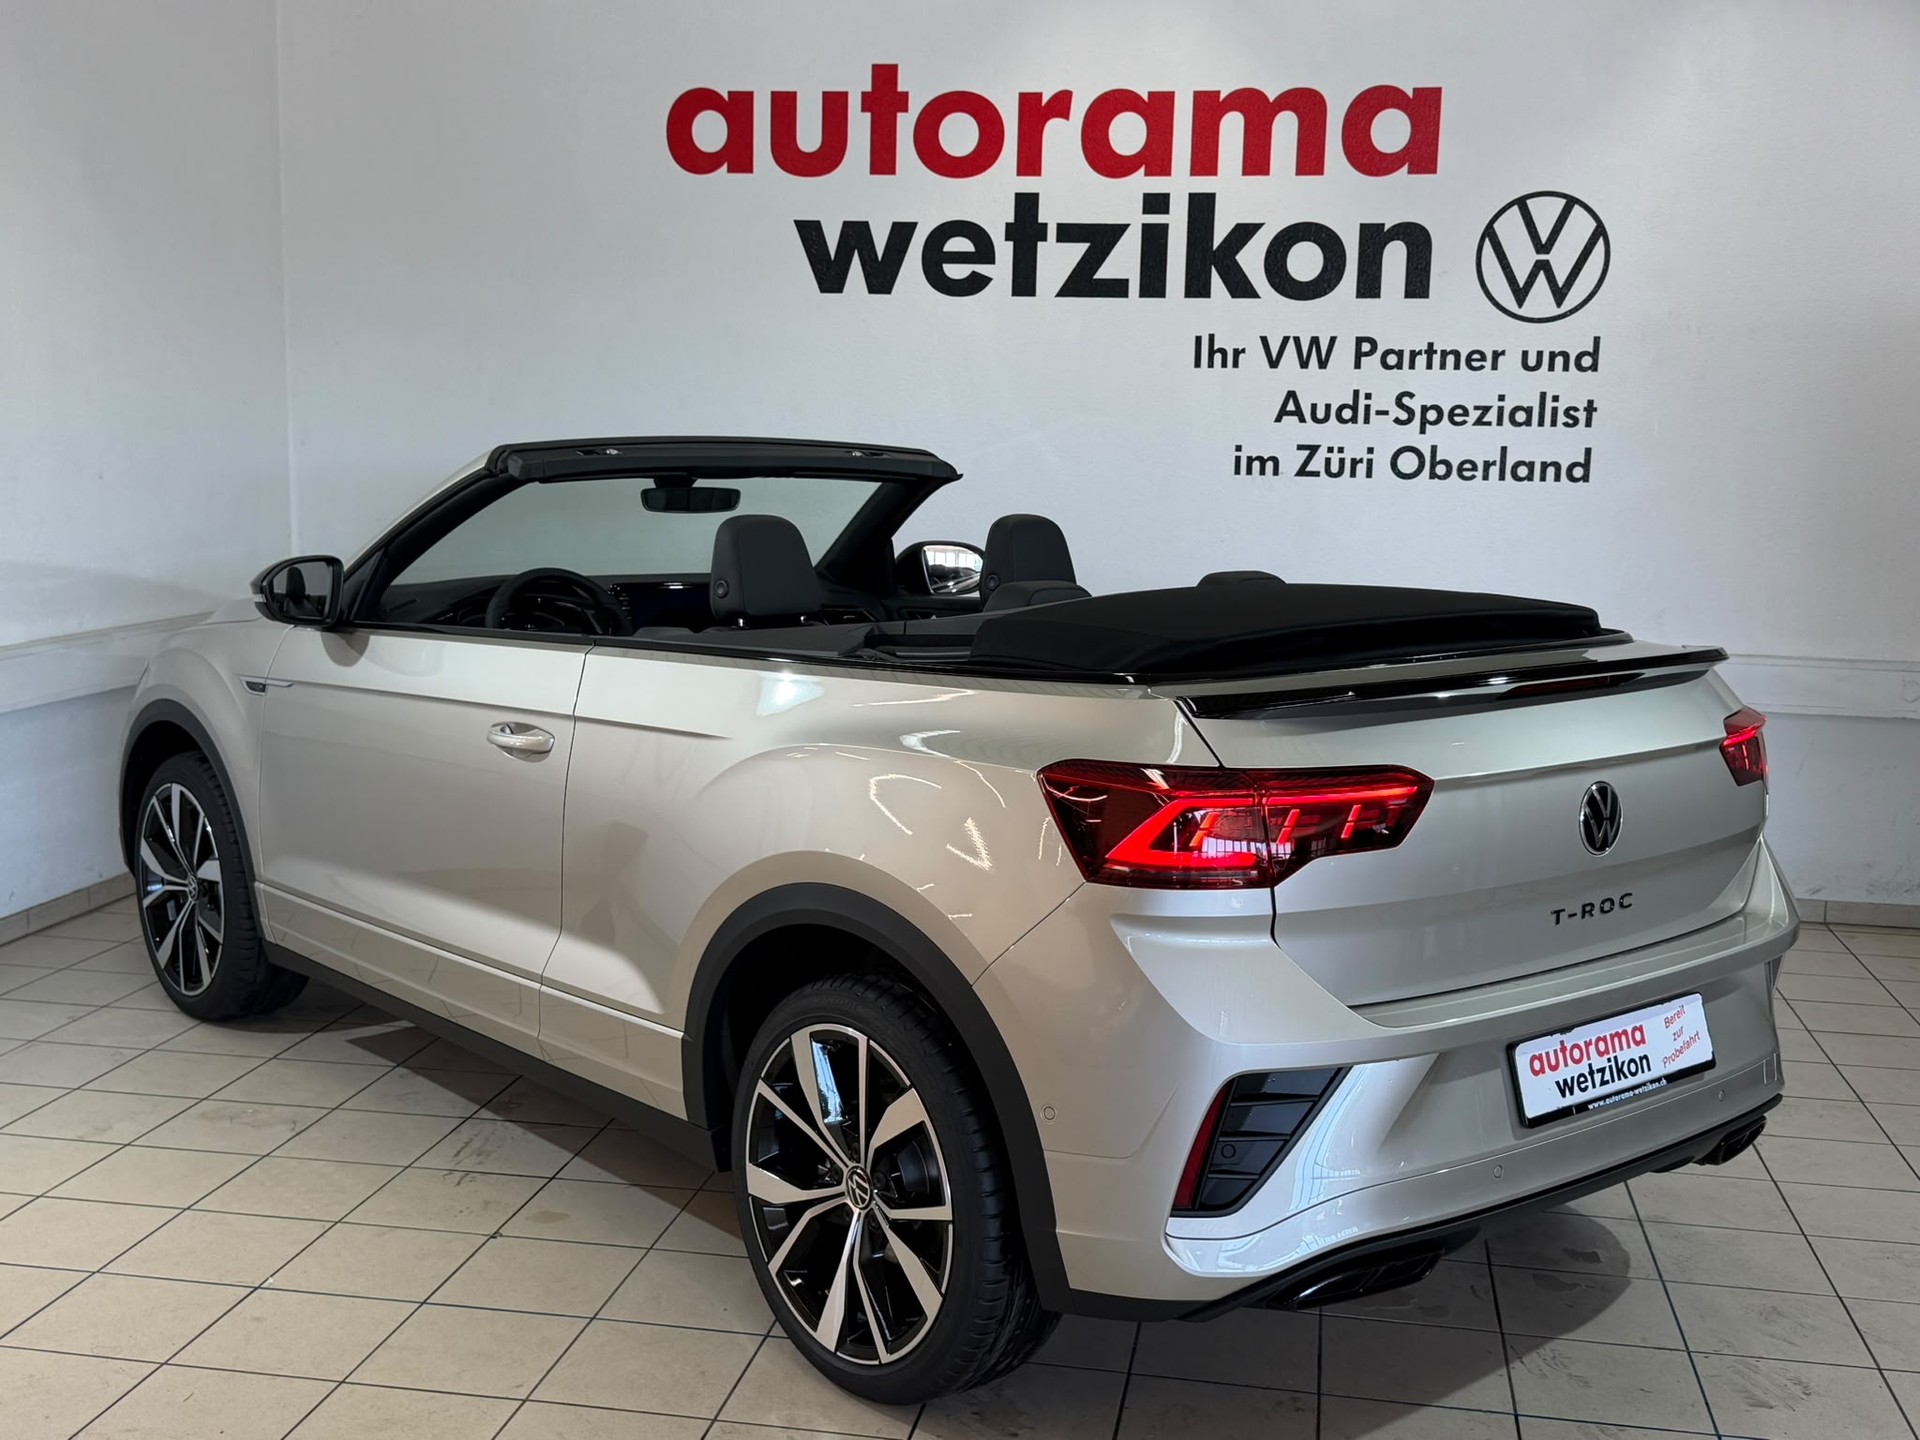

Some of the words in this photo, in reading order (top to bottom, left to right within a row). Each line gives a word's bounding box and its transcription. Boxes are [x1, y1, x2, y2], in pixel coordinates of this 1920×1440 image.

[666, 64, 1443, 180] autorama
[793, 192, 1433, 302] wetzikon
[1193, 333, 1246, 370] Ihr
[1259, 335, 1338, 370] VW
[1353, 336, 1506, 372] Partner
[1521, 335, 1601, 373] und
[1273, 389, 1598, 436] Audi-Spezialist
[1233, 444, 1280, 478] im
[1294, 443, 1375, 480] Züri
[1389, 444, 1593, 484] Oberland
[1551, 892, 1634, 926] T-ROC
[1664, 1004, 1686, 1029] Bereit
[1672, 1026, 1685, 1042] zur
[1529, 1024, 1647, 1077] autorama
[1662, 1030, 1702, 1069] Probefahrt
[1554, 1053, 1652, 1099] wetzikon
